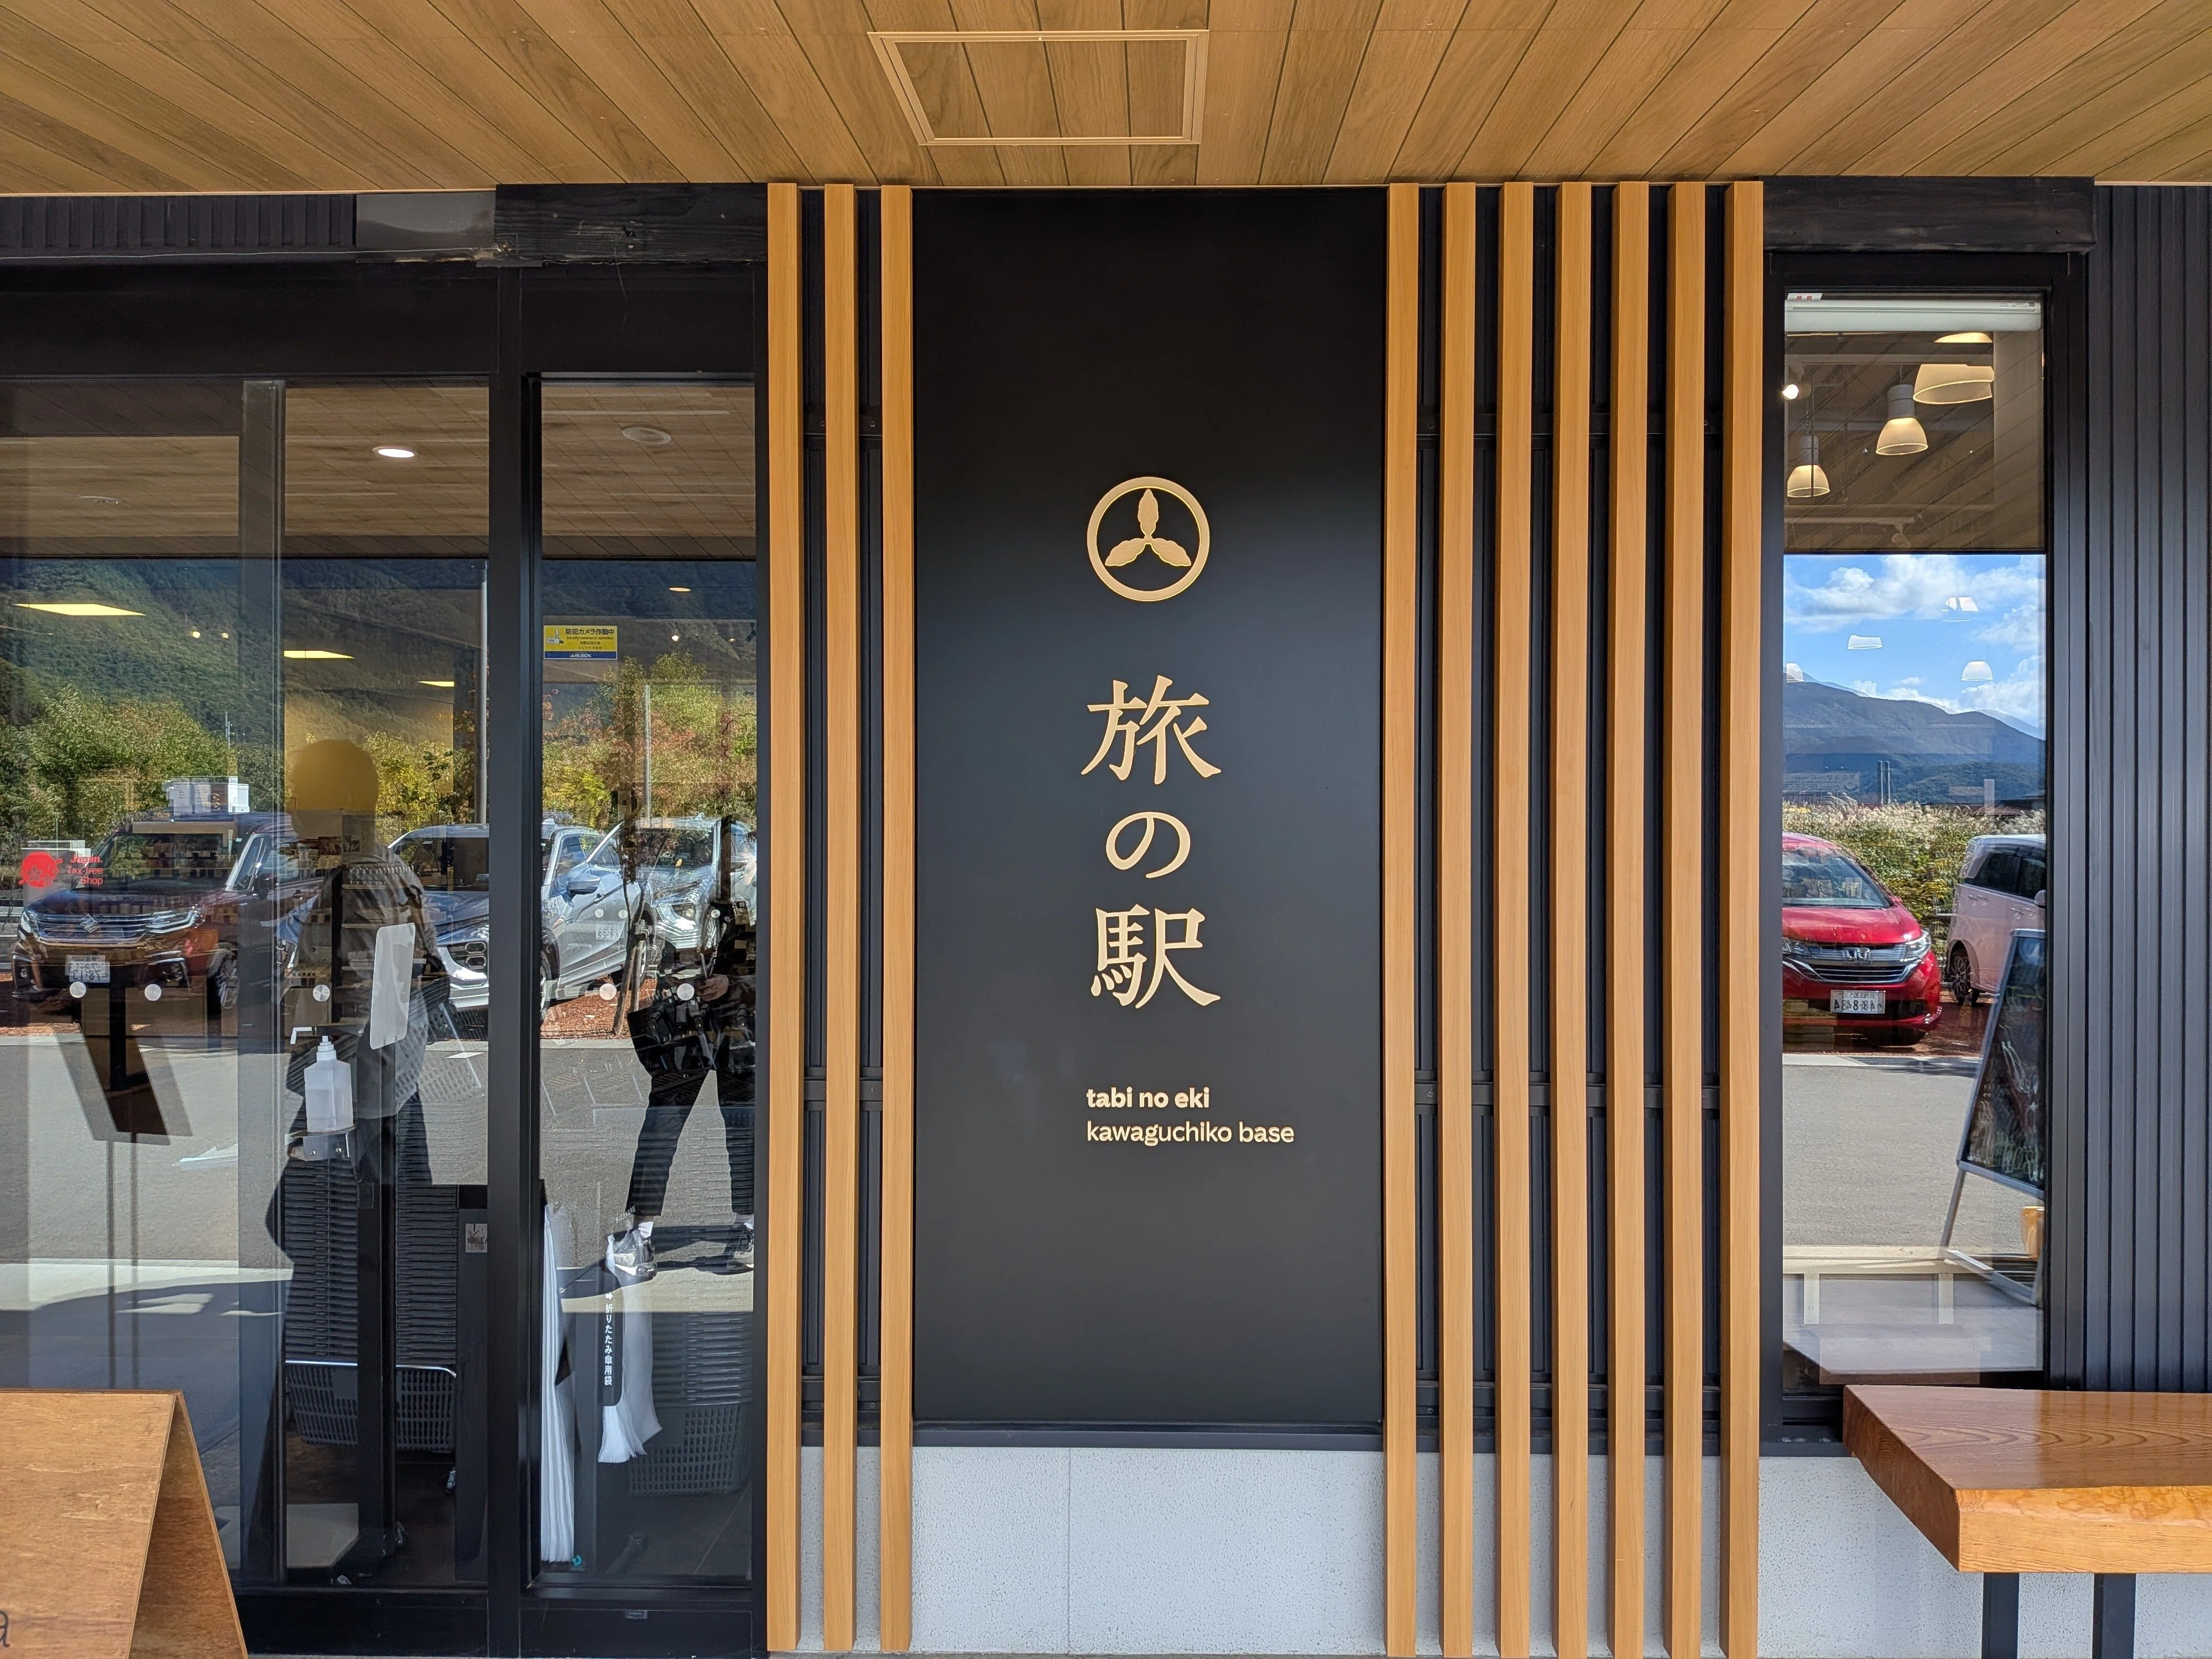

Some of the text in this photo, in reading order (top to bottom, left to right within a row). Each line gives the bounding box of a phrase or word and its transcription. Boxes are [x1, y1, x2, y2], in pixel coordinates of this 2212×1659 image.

[1081, 675, 1221, 1008] 旅の駅
[66, 865, 103, 874] Tax-free
[80, 876, 103, 886] Shop
[1087, 1086, 1209, 1108] tabi no eki
[1087, 1120, 1295, 1146] kawaguchiko base
[604, 1303, 613, 1386] 折りたたみ傘用袋
